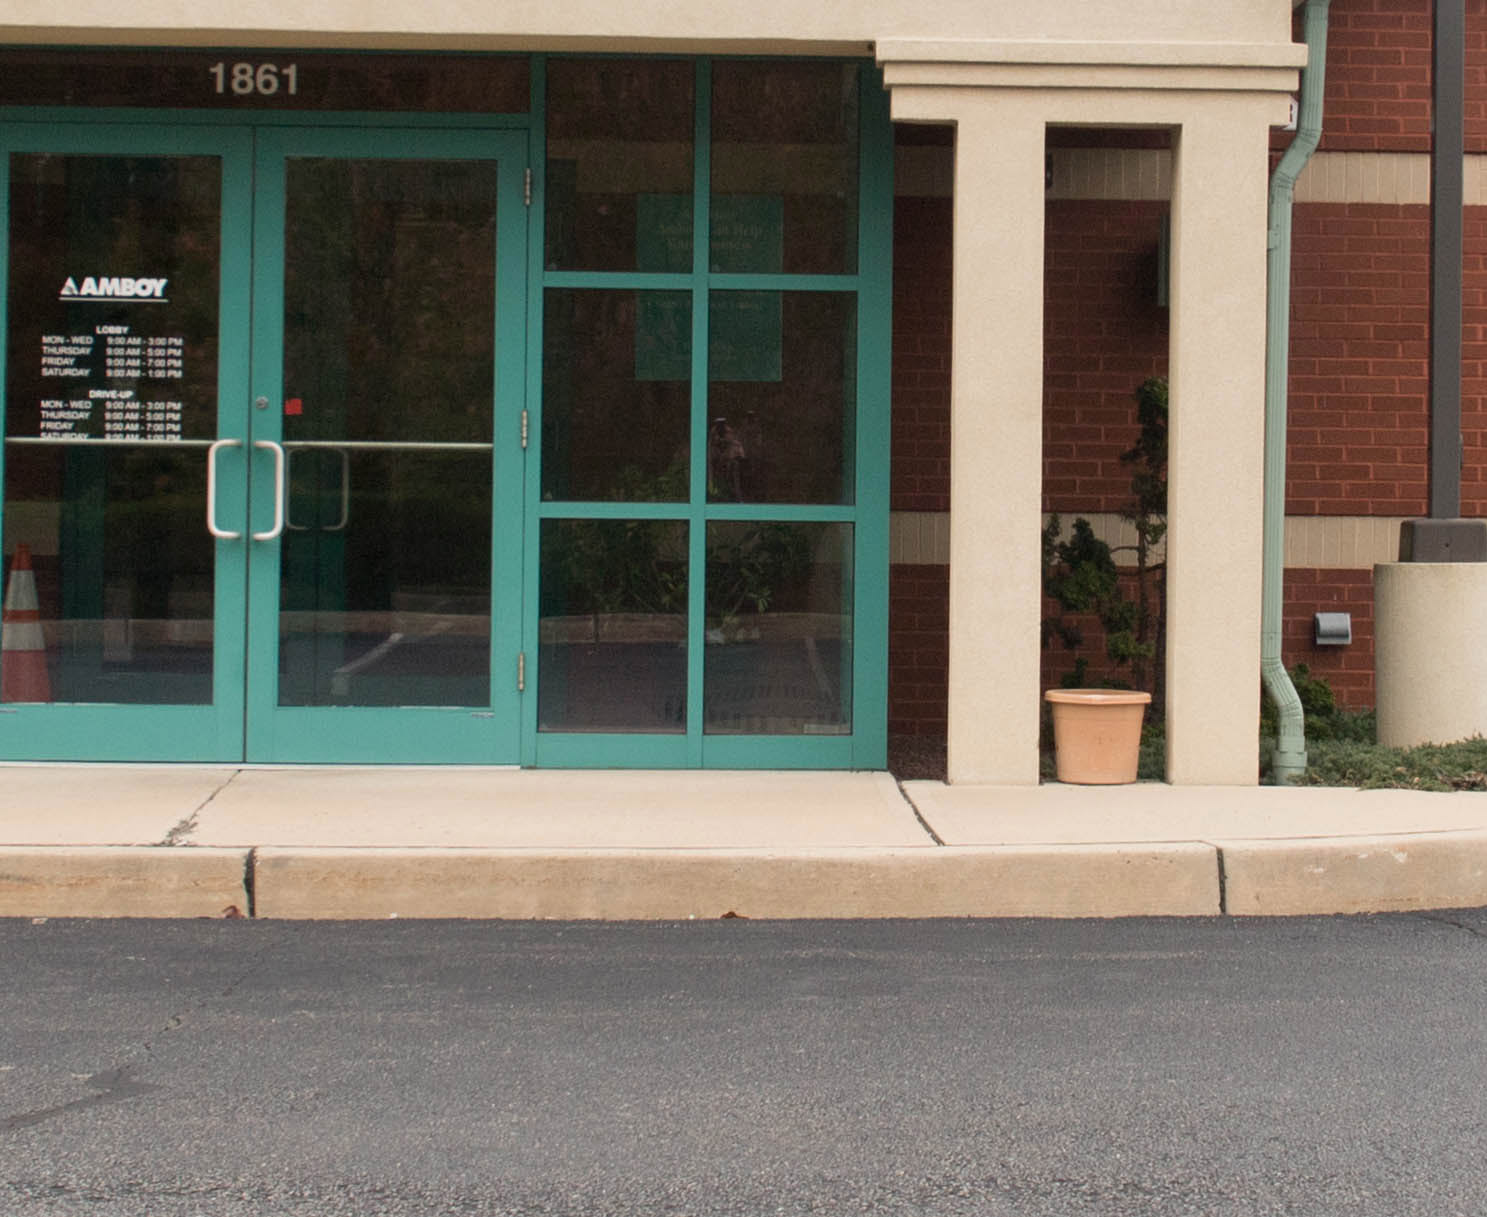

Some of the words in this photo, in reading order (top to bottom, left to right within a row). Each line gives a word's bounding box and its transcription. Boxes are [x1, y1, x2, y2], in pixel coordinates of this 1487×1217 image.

[209, 62, 297, 95] 1861
[80, 277, 168, 297] AMBOY
[96, 325, 129, 334] LOBBY
[42, 336, 64, 344] MON
[71, 336, 93, 344] WED
[126, 337, 141, 345] AM
[166, 337, 183, 346] PM
[42, 346, 91, 355] THURSDAY
[167, 348, 182, 356] PM
[41, 357, 75, 365] FRIDAY
[126, 358, 141, 366] AM
[167, 359, 182, 368] PM
[42, 368, 90, 376] SATURDAY
[126, 369, 141, 377] AM
[167, 370, 182, 378] PM
[88, 390, 134, 399] DRIVE-UP
[40, 400, 63, 408] MON
[70, 400, 92, 409] WED
[125, 401, 141, 409] AM
[165, 401, 182, 410] PM
[40, 411, 90, 419] THURSDAY
[125, 412, 140, 420] AM
[165, 412, 181, 421] PM
[40, 421, 74, 430] FRIDAY
[125, 423, 139, 431] AM
[166, 423, 181, 432] PM
